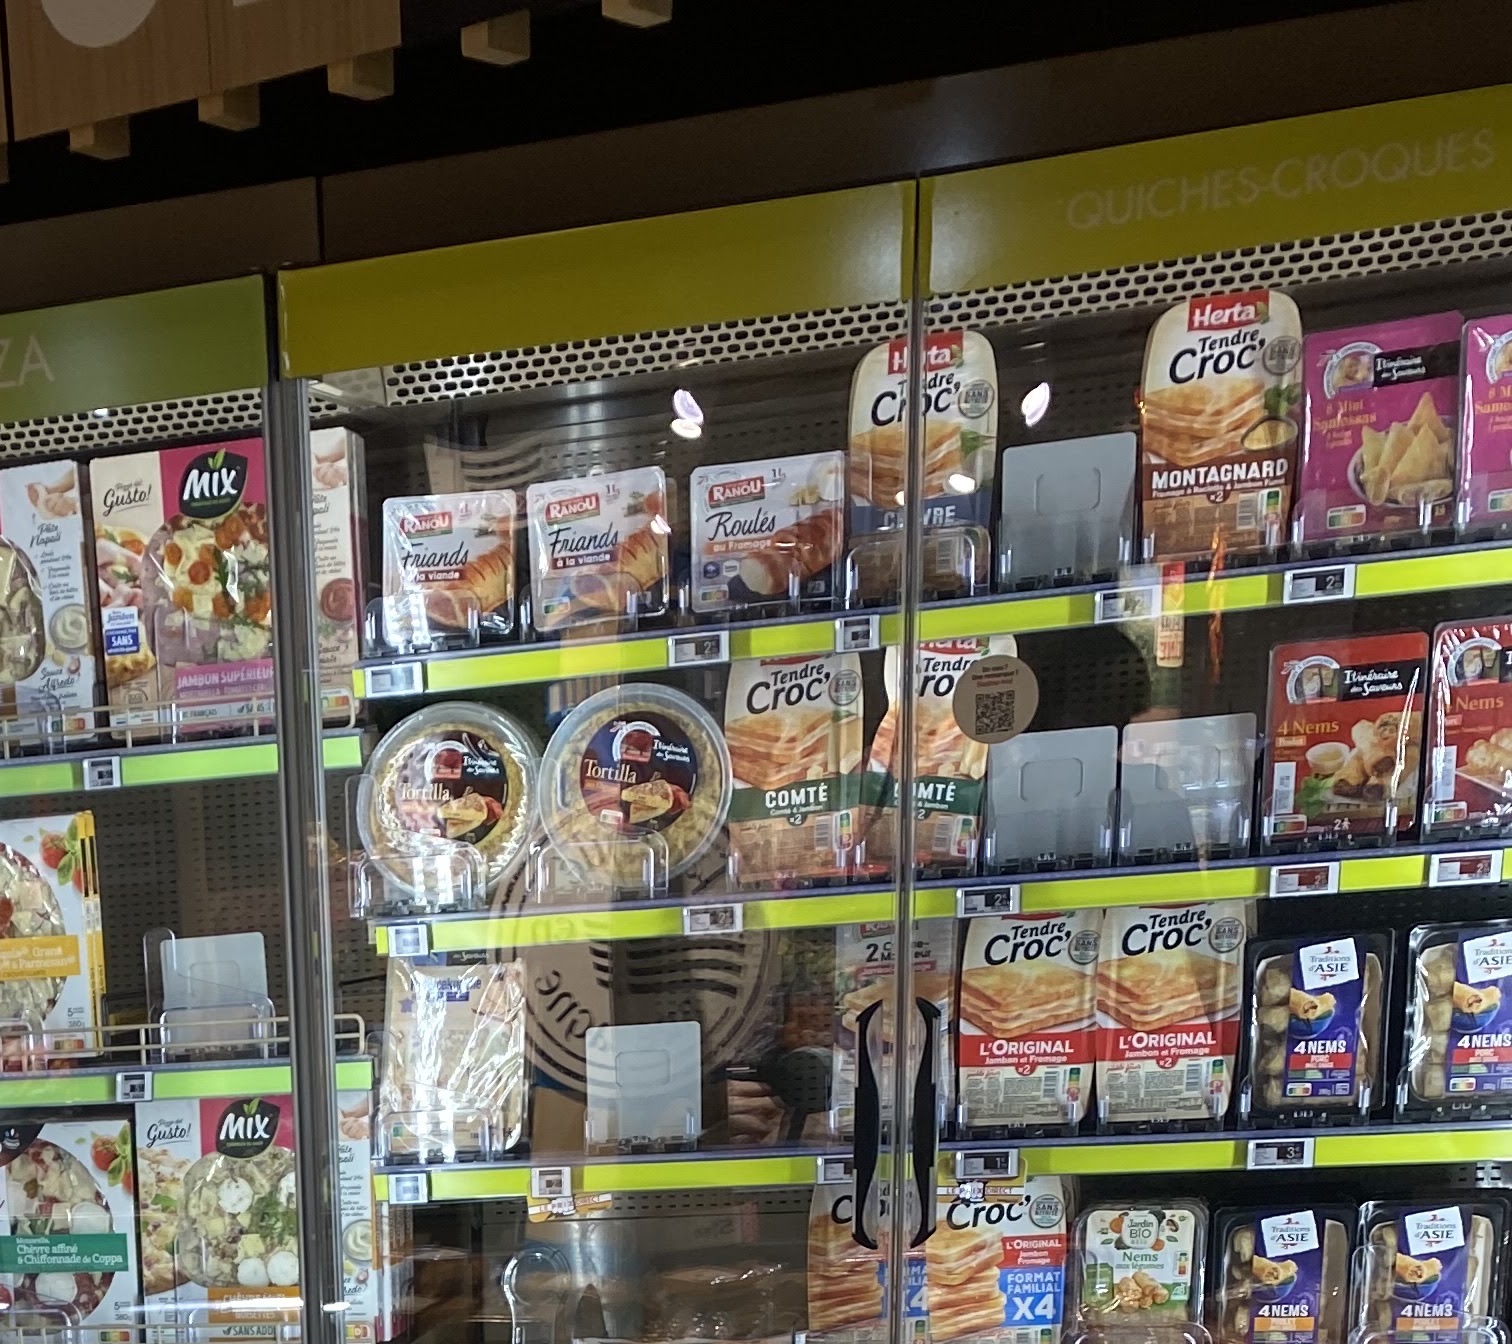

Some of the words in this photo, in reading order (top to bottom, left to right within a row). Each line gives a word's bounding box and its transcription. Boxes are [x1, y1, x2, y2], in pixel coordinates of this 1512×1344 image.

[1191, 303, 1257, 328] Herta
[1198, 328, 1260, 354] Tendre
[182, 468, 239, 501] MIX
[1151, 457, 1289, 491] MONTAGNARD
[102, 485, 153, 517] Gusto!
[711, 478, 763, 504] RANOU
[548, 494, 599, 519] RANOU
[705, 510, 777, 543] Roulés
[548, 526, 620, 560] Friands
[580, 552, 613, 565] viande
[769, 662, 826, 687] Tendre
[1455, 693, 1504, 712] Nems
[1292, 717, 1340, 735] Nems
[583, 758, 639, 785] Tortilla
[764, 784, 829, 809] COMTÉ
[1148, 908, 1207, 930] Tendre
[1011, 920, 1066, 942] Tendre
[1309, 954, 1351, 964] Traditions
[1170, 1045, 1210, 1057] Fromage
[1307, 1039, 1347, 1054] NEMS
[145, 1122, 192, 1150] Gusto!
[219, 1111, 271, 1142] MIX
[16, 1243, 51, 1255] Chèvre
[51, 1242, 79, 1254] affiné
[23, 1253, 82, 1265] Chiffonnade
[92, 1252, 124, 1266] Coppa
[1121, 1250, 1159, 1263] Nems
[1006, 1282, 1061, 1295] FAMILIAL
[1007, 1271, 1061, 1285] FORMAT
[1271, 1304, 1309, 1317] NEMS
